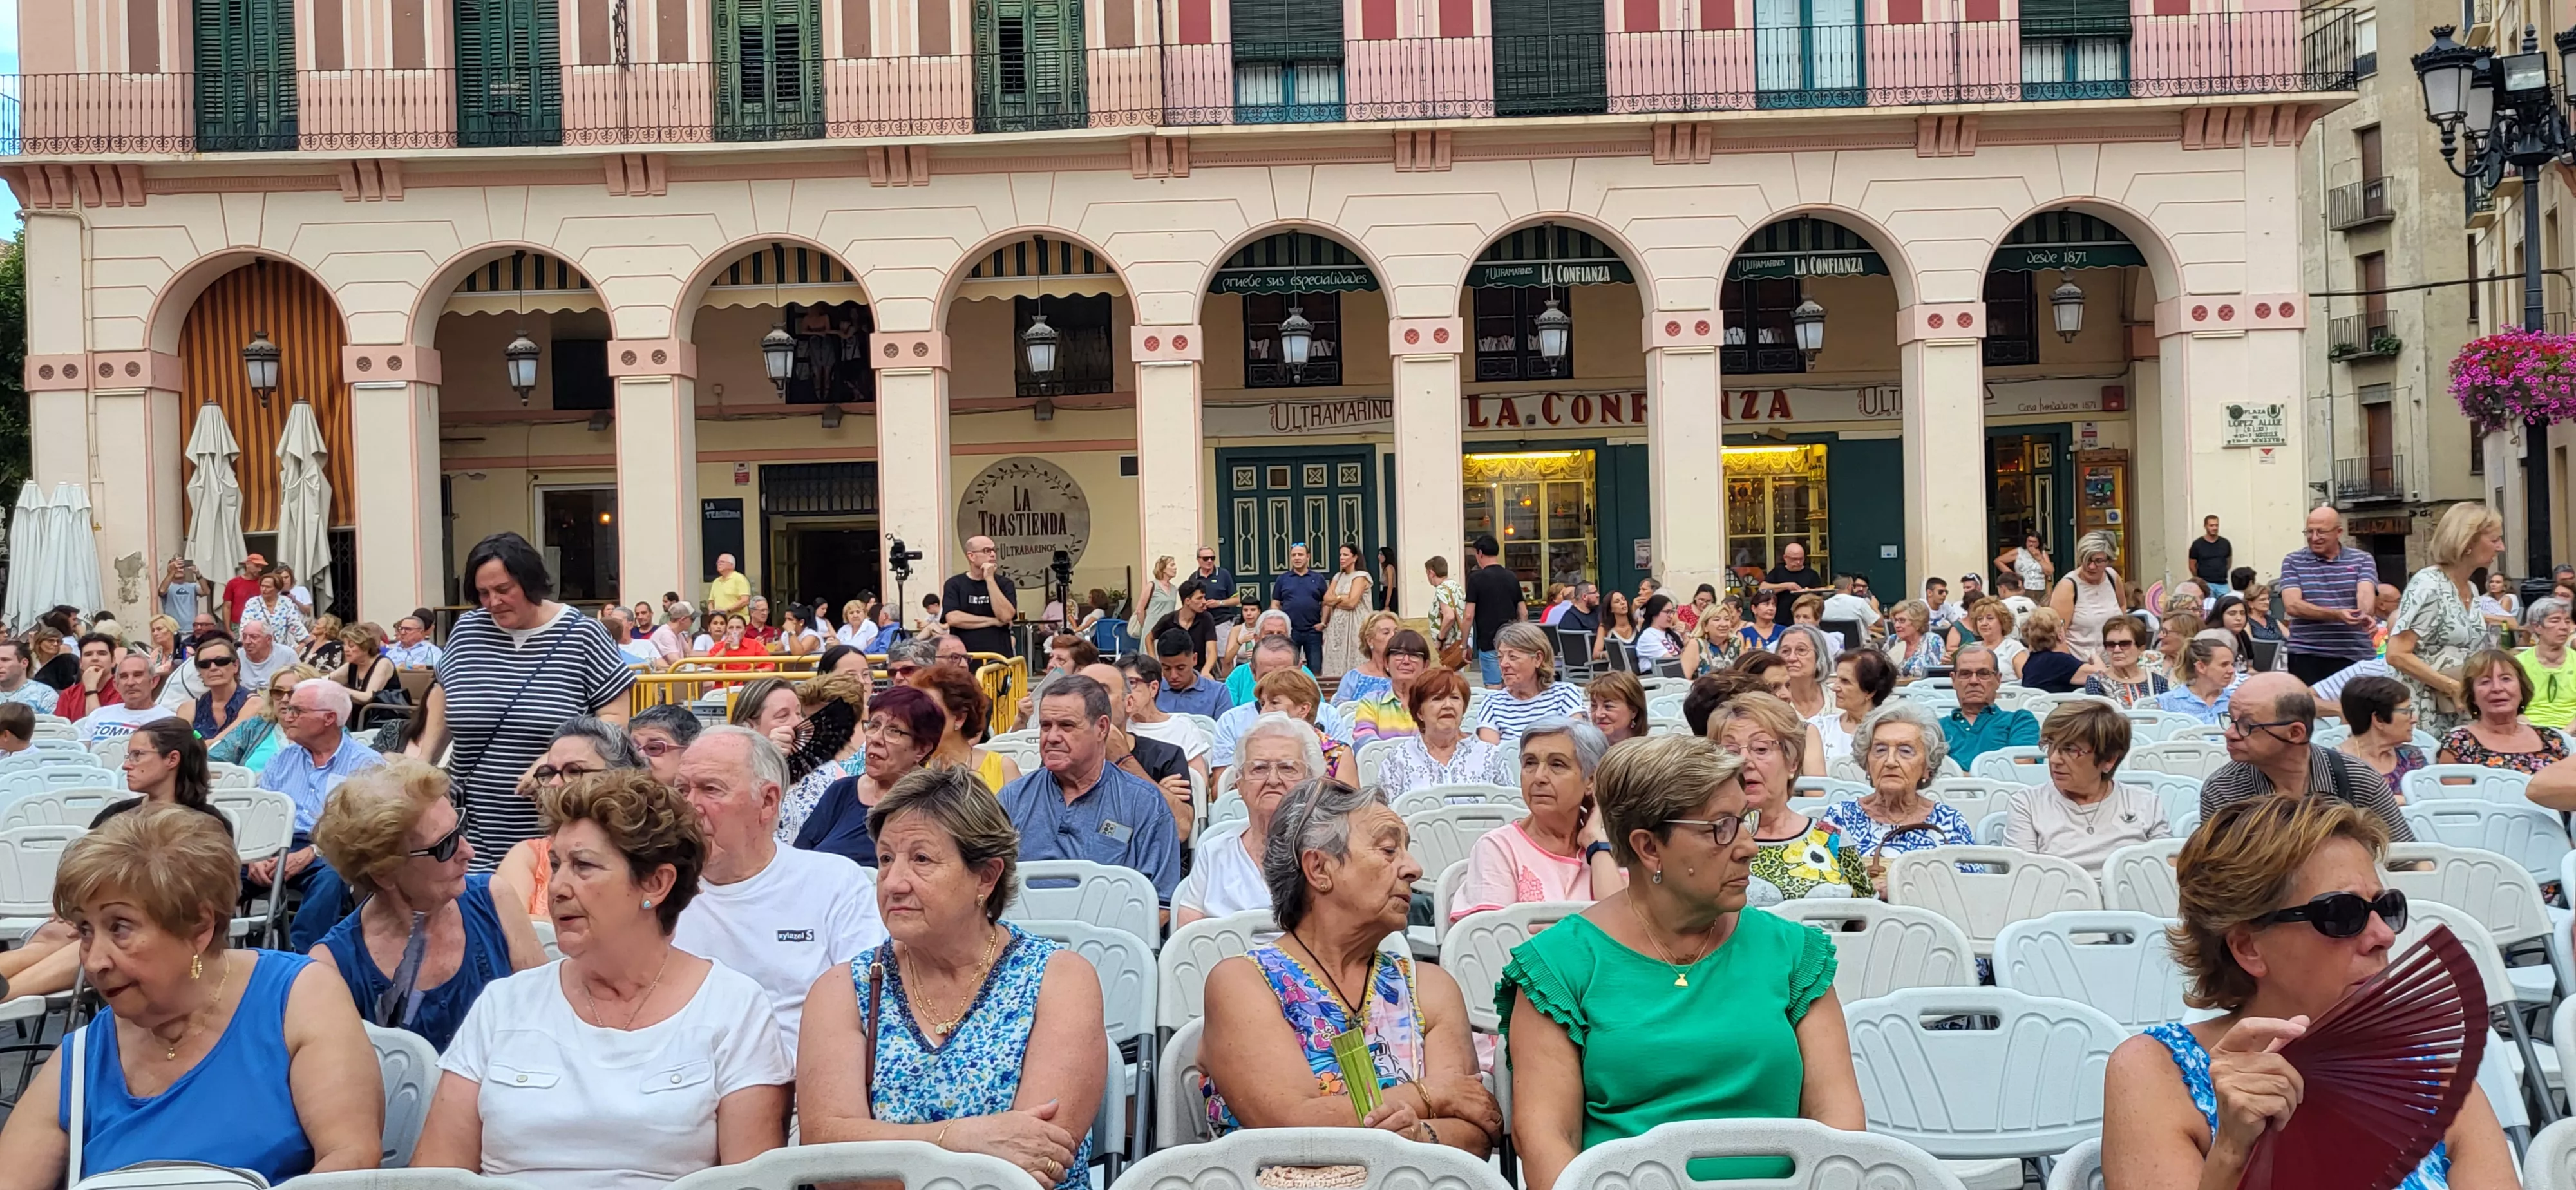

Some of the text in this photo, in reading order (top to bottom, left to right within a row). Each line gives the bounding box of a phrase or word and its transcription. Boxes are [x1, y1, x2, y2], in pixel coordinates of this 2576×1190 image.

[1794, 257, 1807, 275] LA
[1810, 256, 1864, 274] CONFIANZA
[2026, 249, 2087, 265] desde 1871
[1265, 276, 1285, 287] sus
[1290, 270, 1368, 290] especialidades
[1541, 265, 1553, 283] LA
[1557, 265, 1611, 283] CONFIANZA
[1274, 399, 1393, 431] ULTRAMARINO
[1467, 394, 1520, 428] LA
[1013, 486, 1032, 512] LA
[978, 511, 1068, 537] TRASTIENDA
[1000, 543, 1057, 560] ULTRABARINOS
[95, 726, 137, 736] TOMM
[805, 929, 813, 940] S
